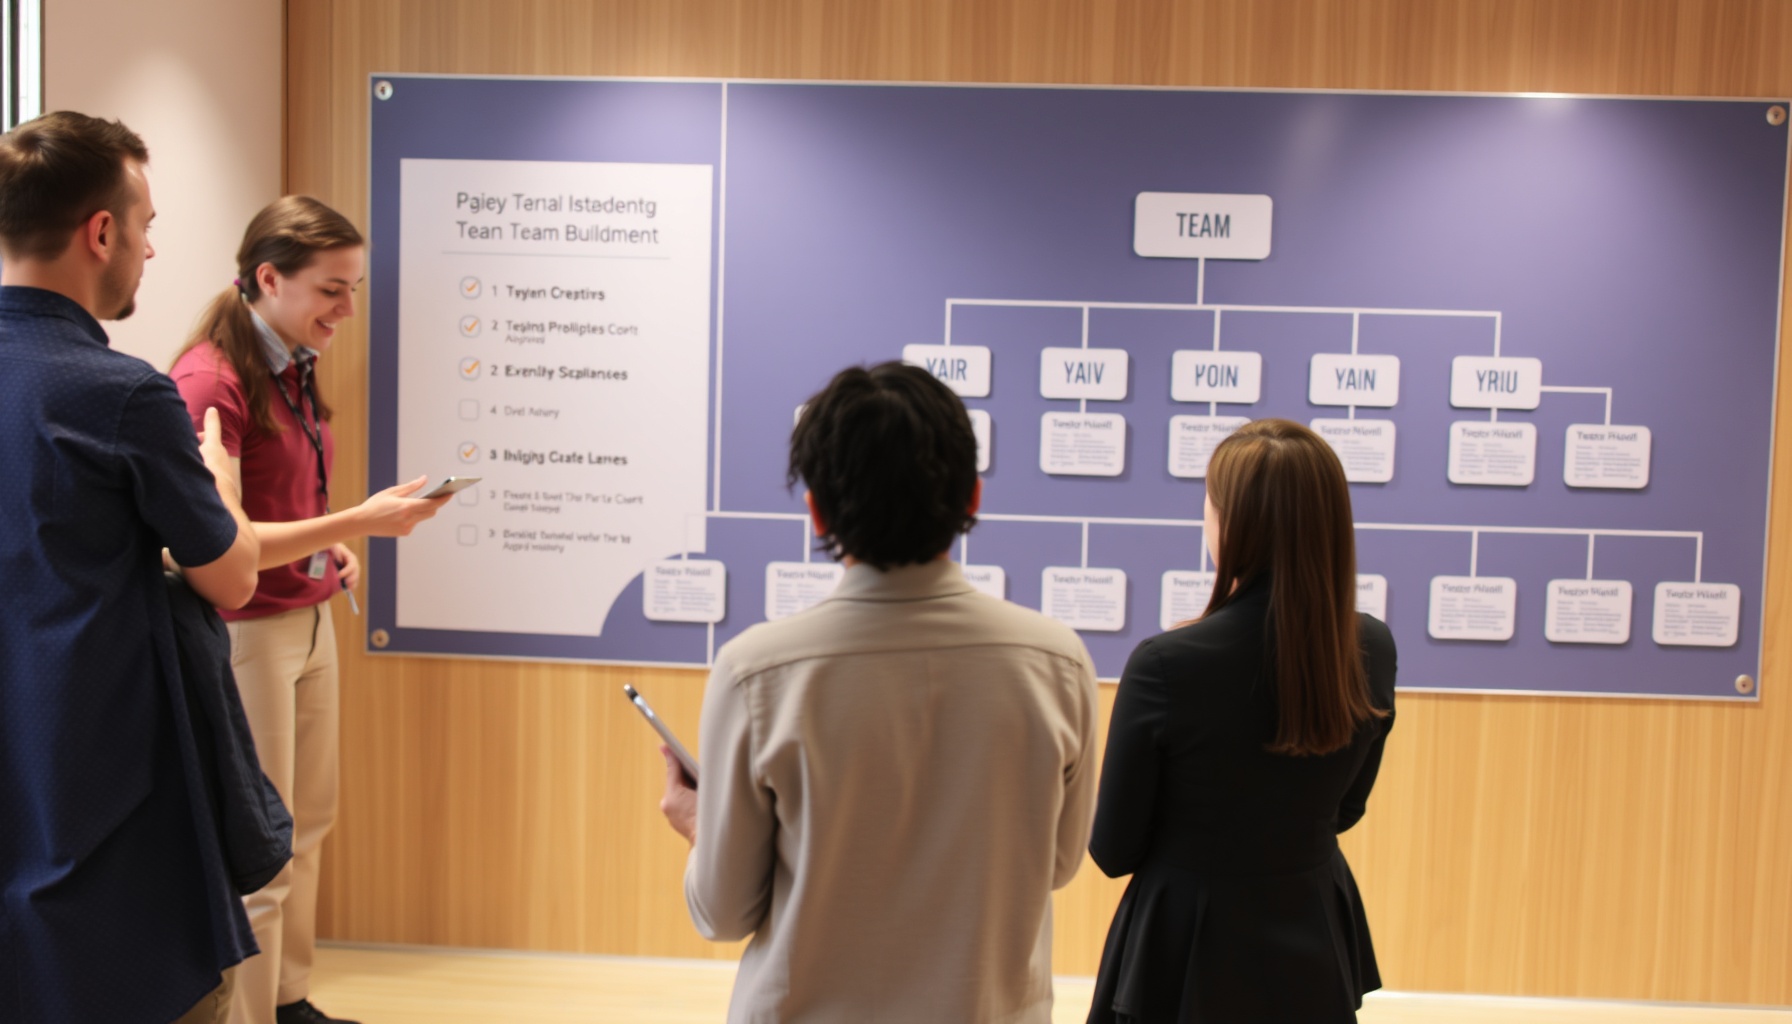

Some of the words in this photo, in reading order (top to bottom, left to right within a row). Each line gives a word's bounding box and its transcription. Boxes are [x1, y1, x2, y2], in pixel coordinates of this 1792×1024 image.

[456, 220, 502, 239] Tean
[510, 222, 559, 241] Team
[1176, 212, 1230, 238] TEAM
[926, 357, 968, 381] YAIR
[1064, 361, 1105, 385] YAIV
[1335, 368, 1376, 391] YAIN
[1476, 370, 1518, 393] YRIU
